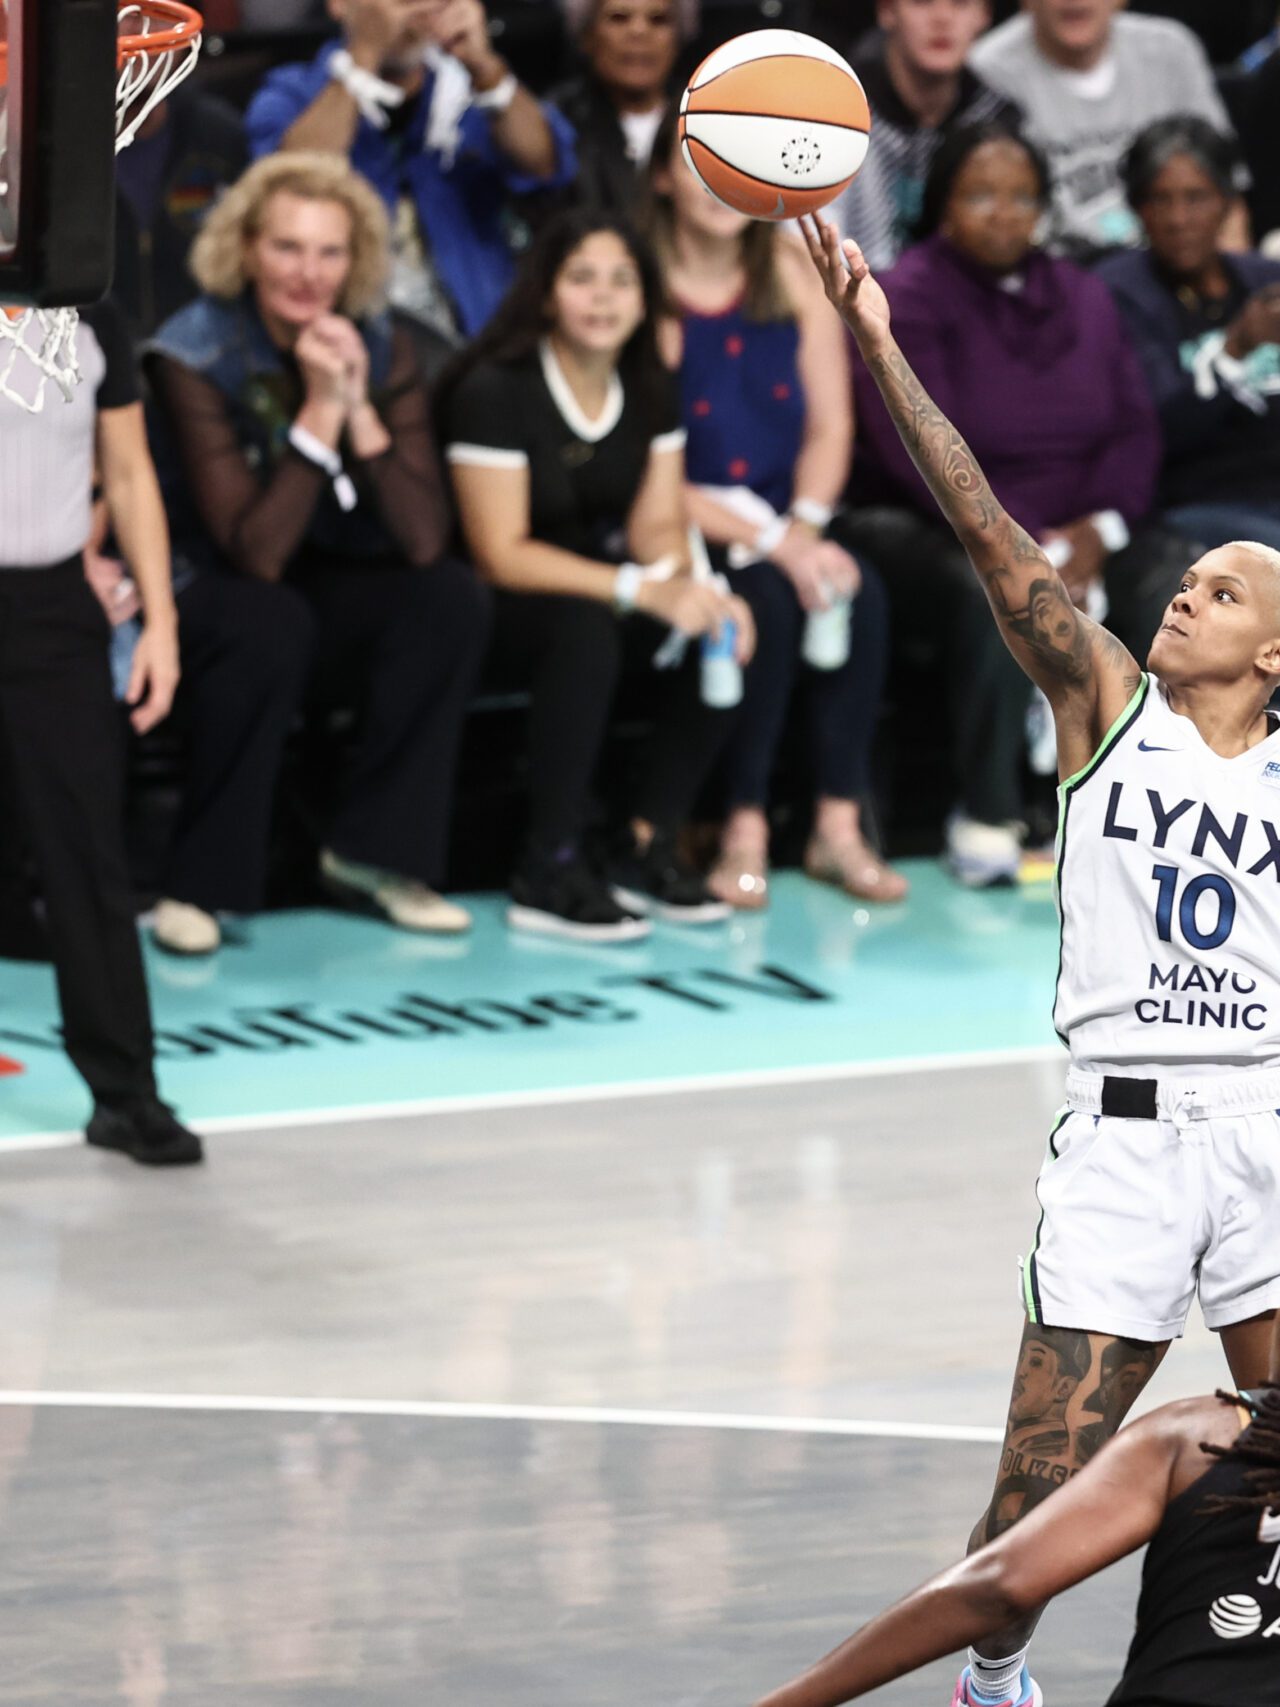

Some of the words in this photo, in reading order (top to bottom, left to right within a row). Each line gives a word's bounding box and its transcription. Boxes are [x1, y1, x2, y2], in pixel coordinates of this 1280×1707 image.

[1151, 864, 1237, 951] 10
[598, 964, 834, 1012] TV
[1149, 963, 1257, 994] MAYO
[1135, 999, 1268, 1031] CLINIC
